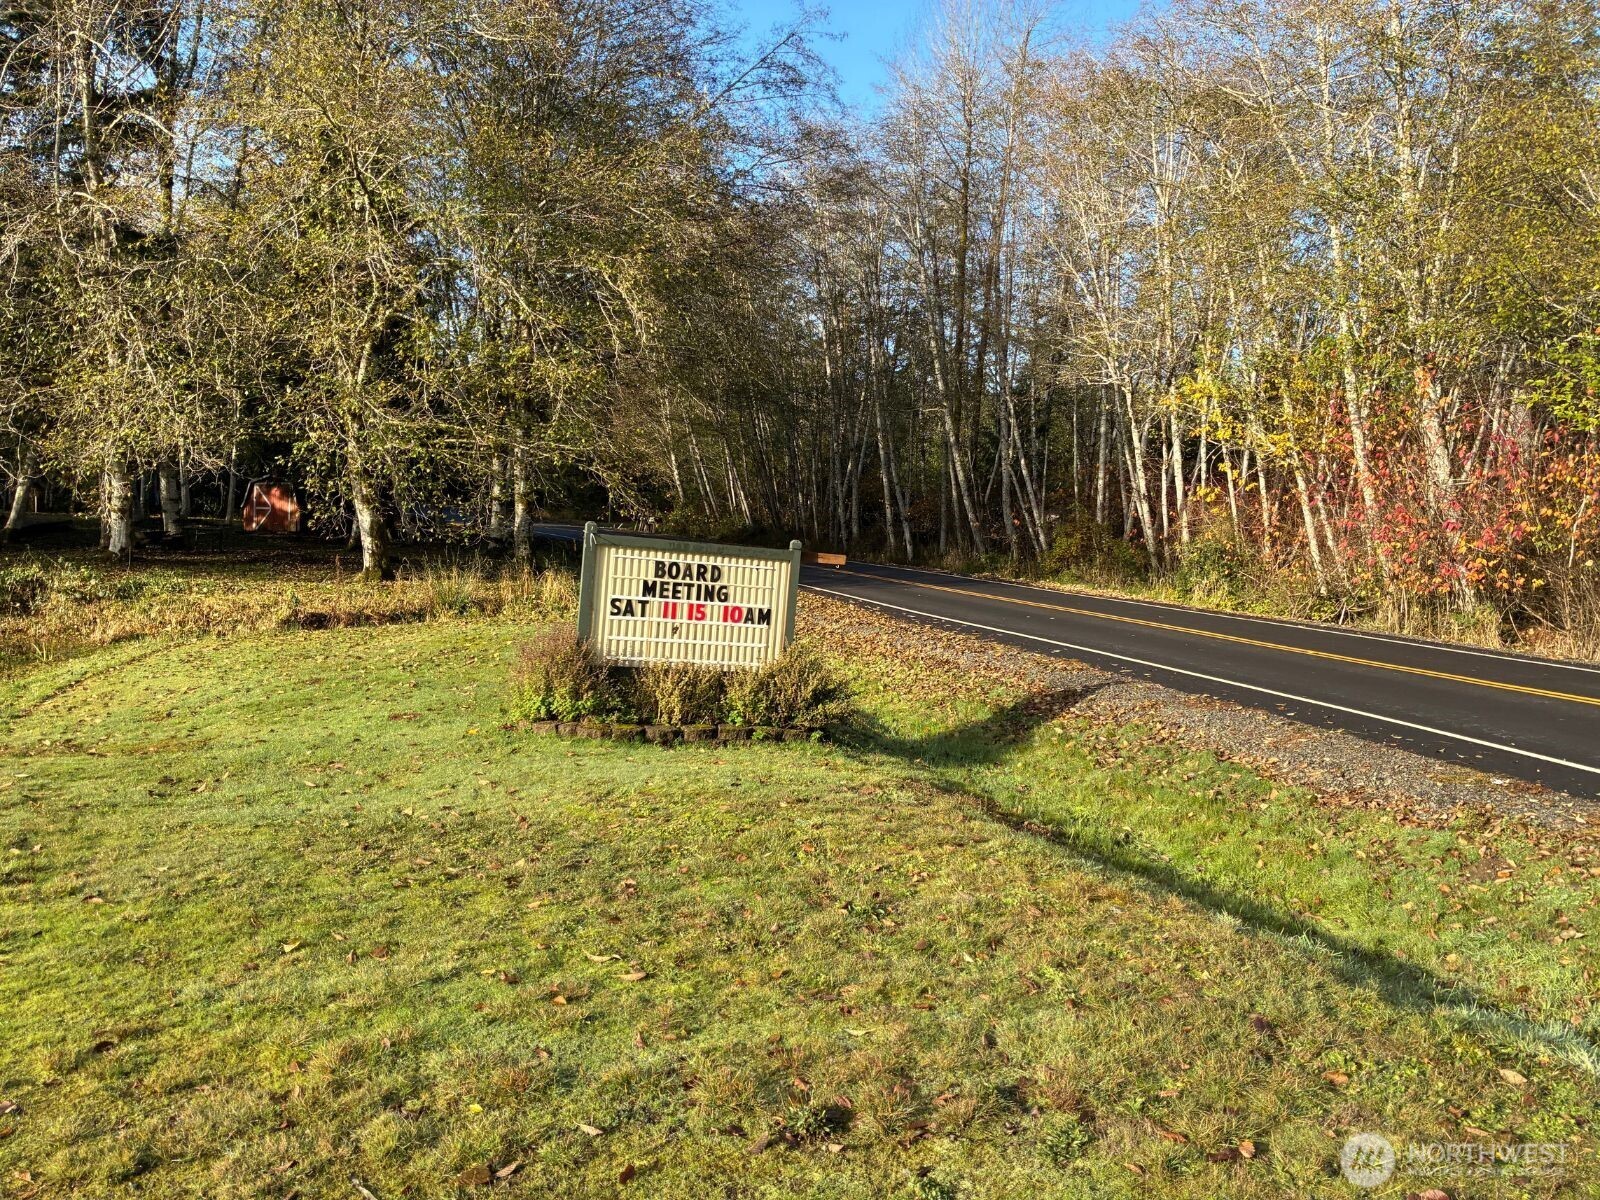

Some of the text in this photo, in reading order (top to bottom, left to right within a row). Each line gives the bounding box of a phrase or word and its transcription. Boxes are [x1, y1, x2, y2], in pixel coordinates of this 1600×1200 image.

[654, 560, 721, 583] BOARD
[642, 580, 728, 602] MEETING
[610, 598, 649, 618] SAT
[662, 601, 678, 620] 11
[687, 603, 706, 621] 15
